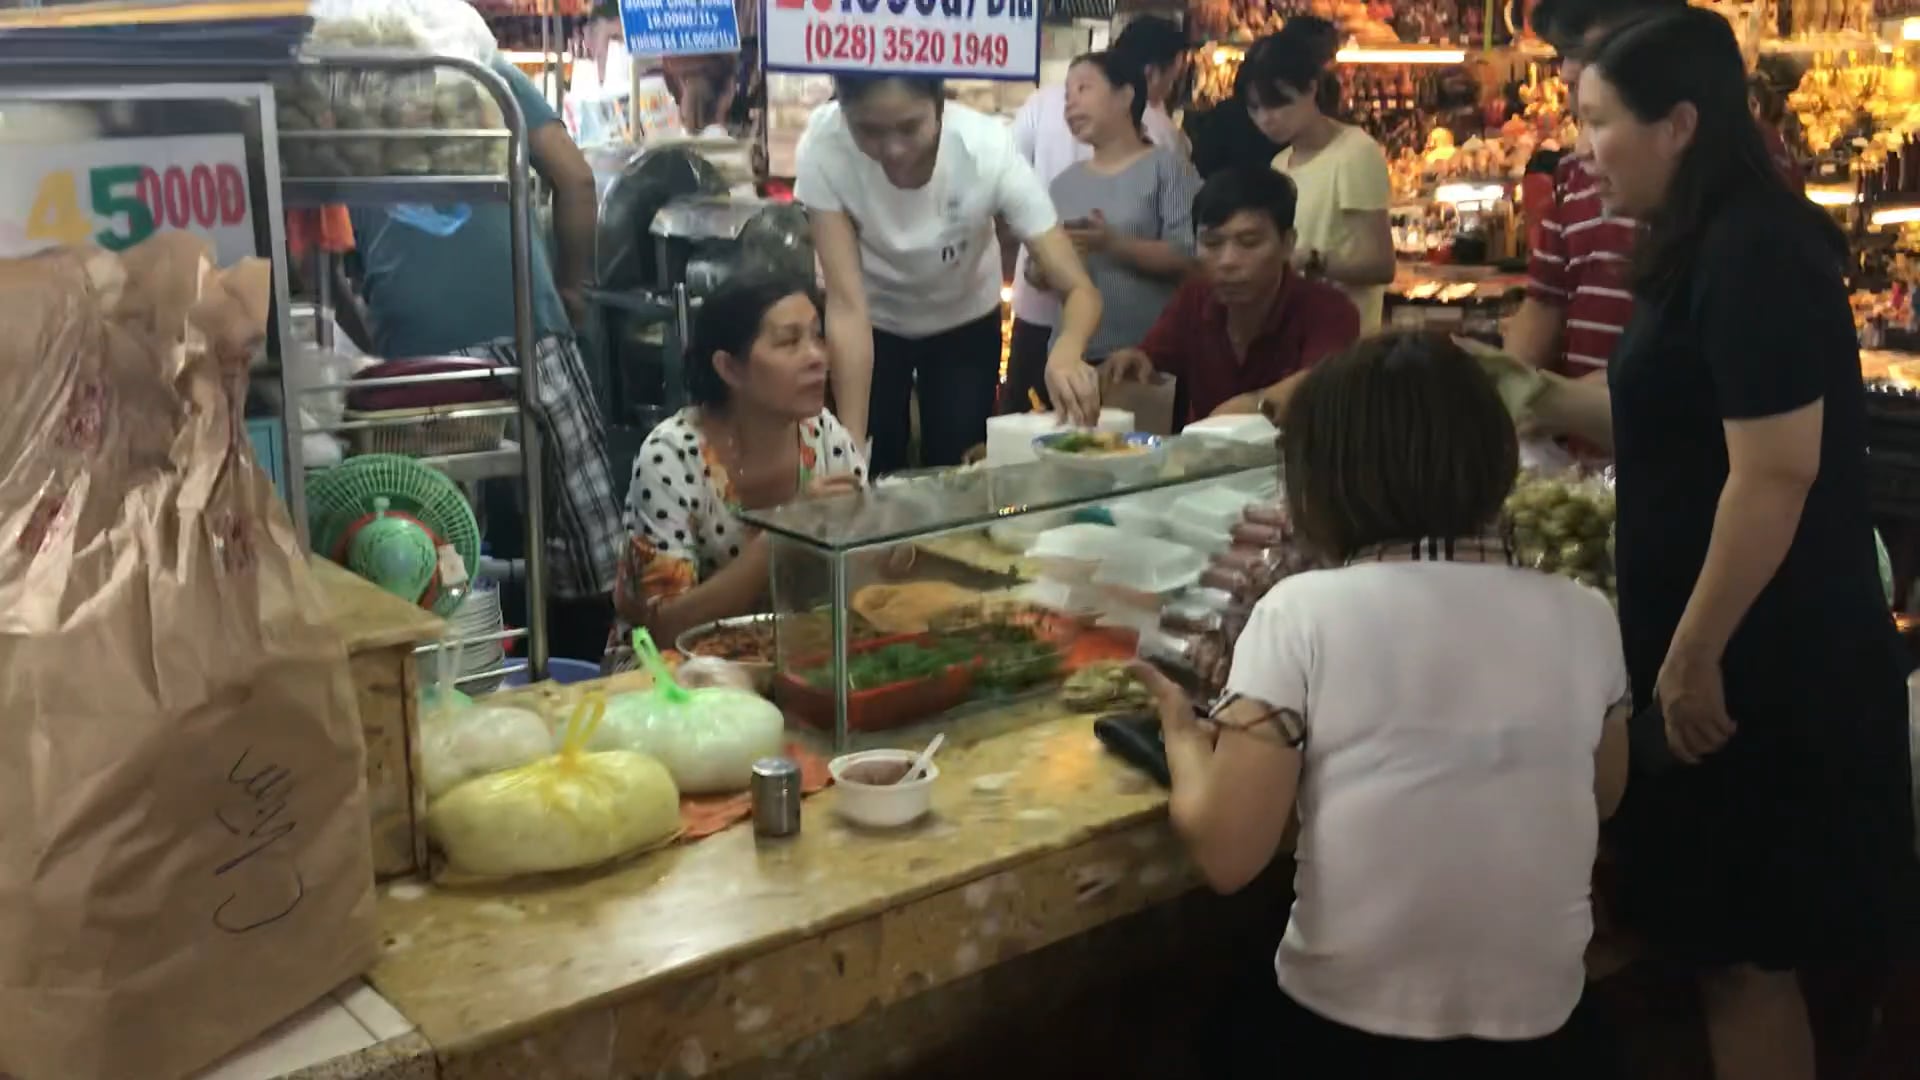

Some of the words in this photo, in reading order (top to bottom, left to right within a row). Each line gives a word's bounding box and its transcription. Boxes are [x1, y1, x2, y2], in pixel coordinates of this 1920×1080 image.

[804, 20, 876, 65] (028)
[883, 25, 945, 64] 3520
[952, 31, 1009, 67] 1949
